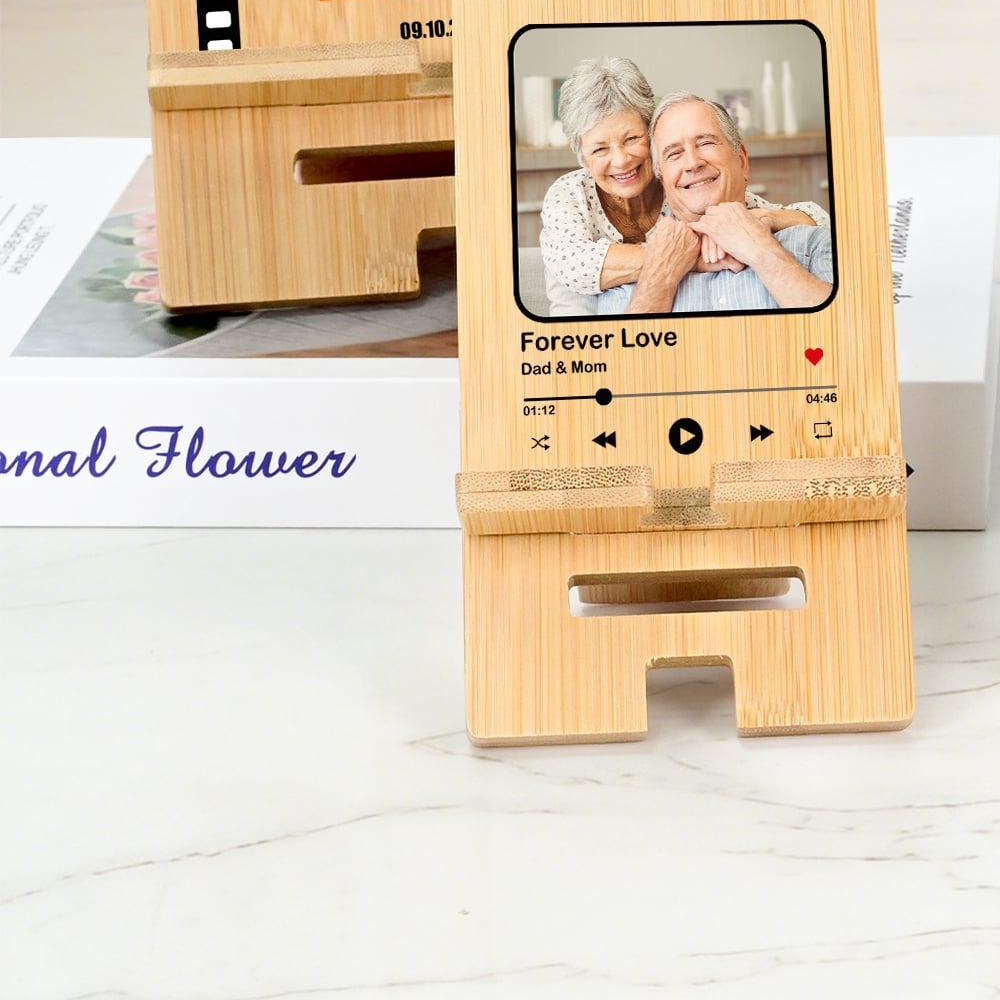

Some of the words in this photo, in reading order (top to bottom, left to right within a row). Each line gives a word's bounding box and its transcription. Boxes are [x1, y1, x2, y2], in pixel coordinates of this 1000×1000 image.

[399, 19, 453, 40] 09.10.
[520, 330, 615, 353] Forever
[621, 327, 678, 348] Love
[521, 361, 552, 376] Dad
[555, 361, 568, 375] &
[571, 360, 608, 374] Mom
[805, 392, 838, 405] 04:46
[523, 404, 556, 417] 01:12
[135, 425, 357, 479] Flower
